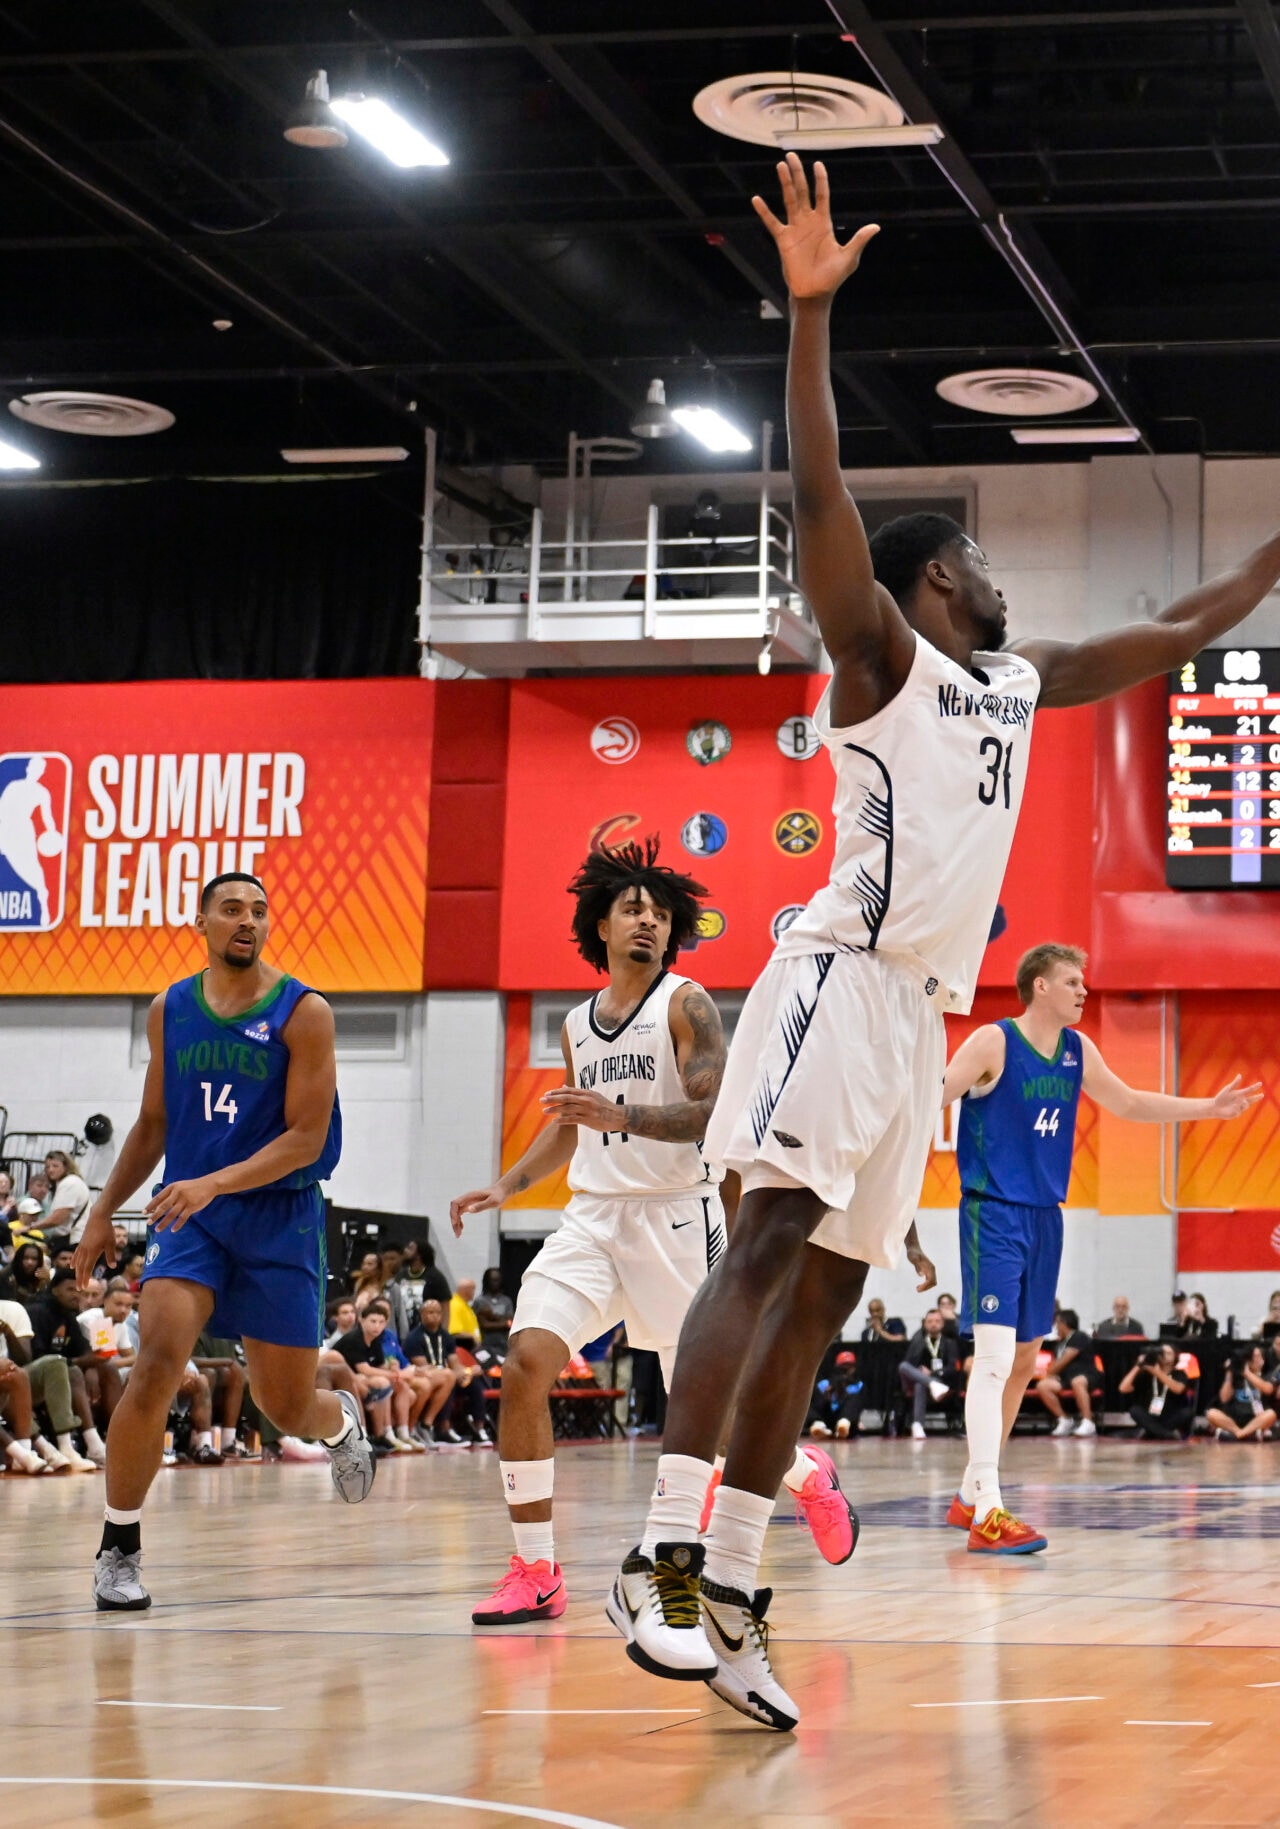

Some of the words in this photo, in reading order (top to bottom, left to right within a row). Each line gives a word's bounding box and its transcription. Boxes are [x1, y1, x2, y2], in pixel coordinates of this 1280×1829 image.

[1180, 661, 1196, 682] 2
[1237, 716, 1260, 735] 21
[1240, 745, 1255, 765] 2
[978, 737, 1013, 809] 31
[1236, 771, 1261, 791] 12
[85, 753, 306, 838] SUMMER
[1240, 800, 1255, 820] 0
[1240, 828, 1255, 848] 2
[0, 891, 32, 919] NBA
[175, 1040, 268, 1081] WOLVES
[579, 1060, 598, 1090] NEW
[601, 1053, 656, 1083] ORLEANS
[201, 1082, 238, 1124] 14
[1033, 1107, 1060, 1138] 44
